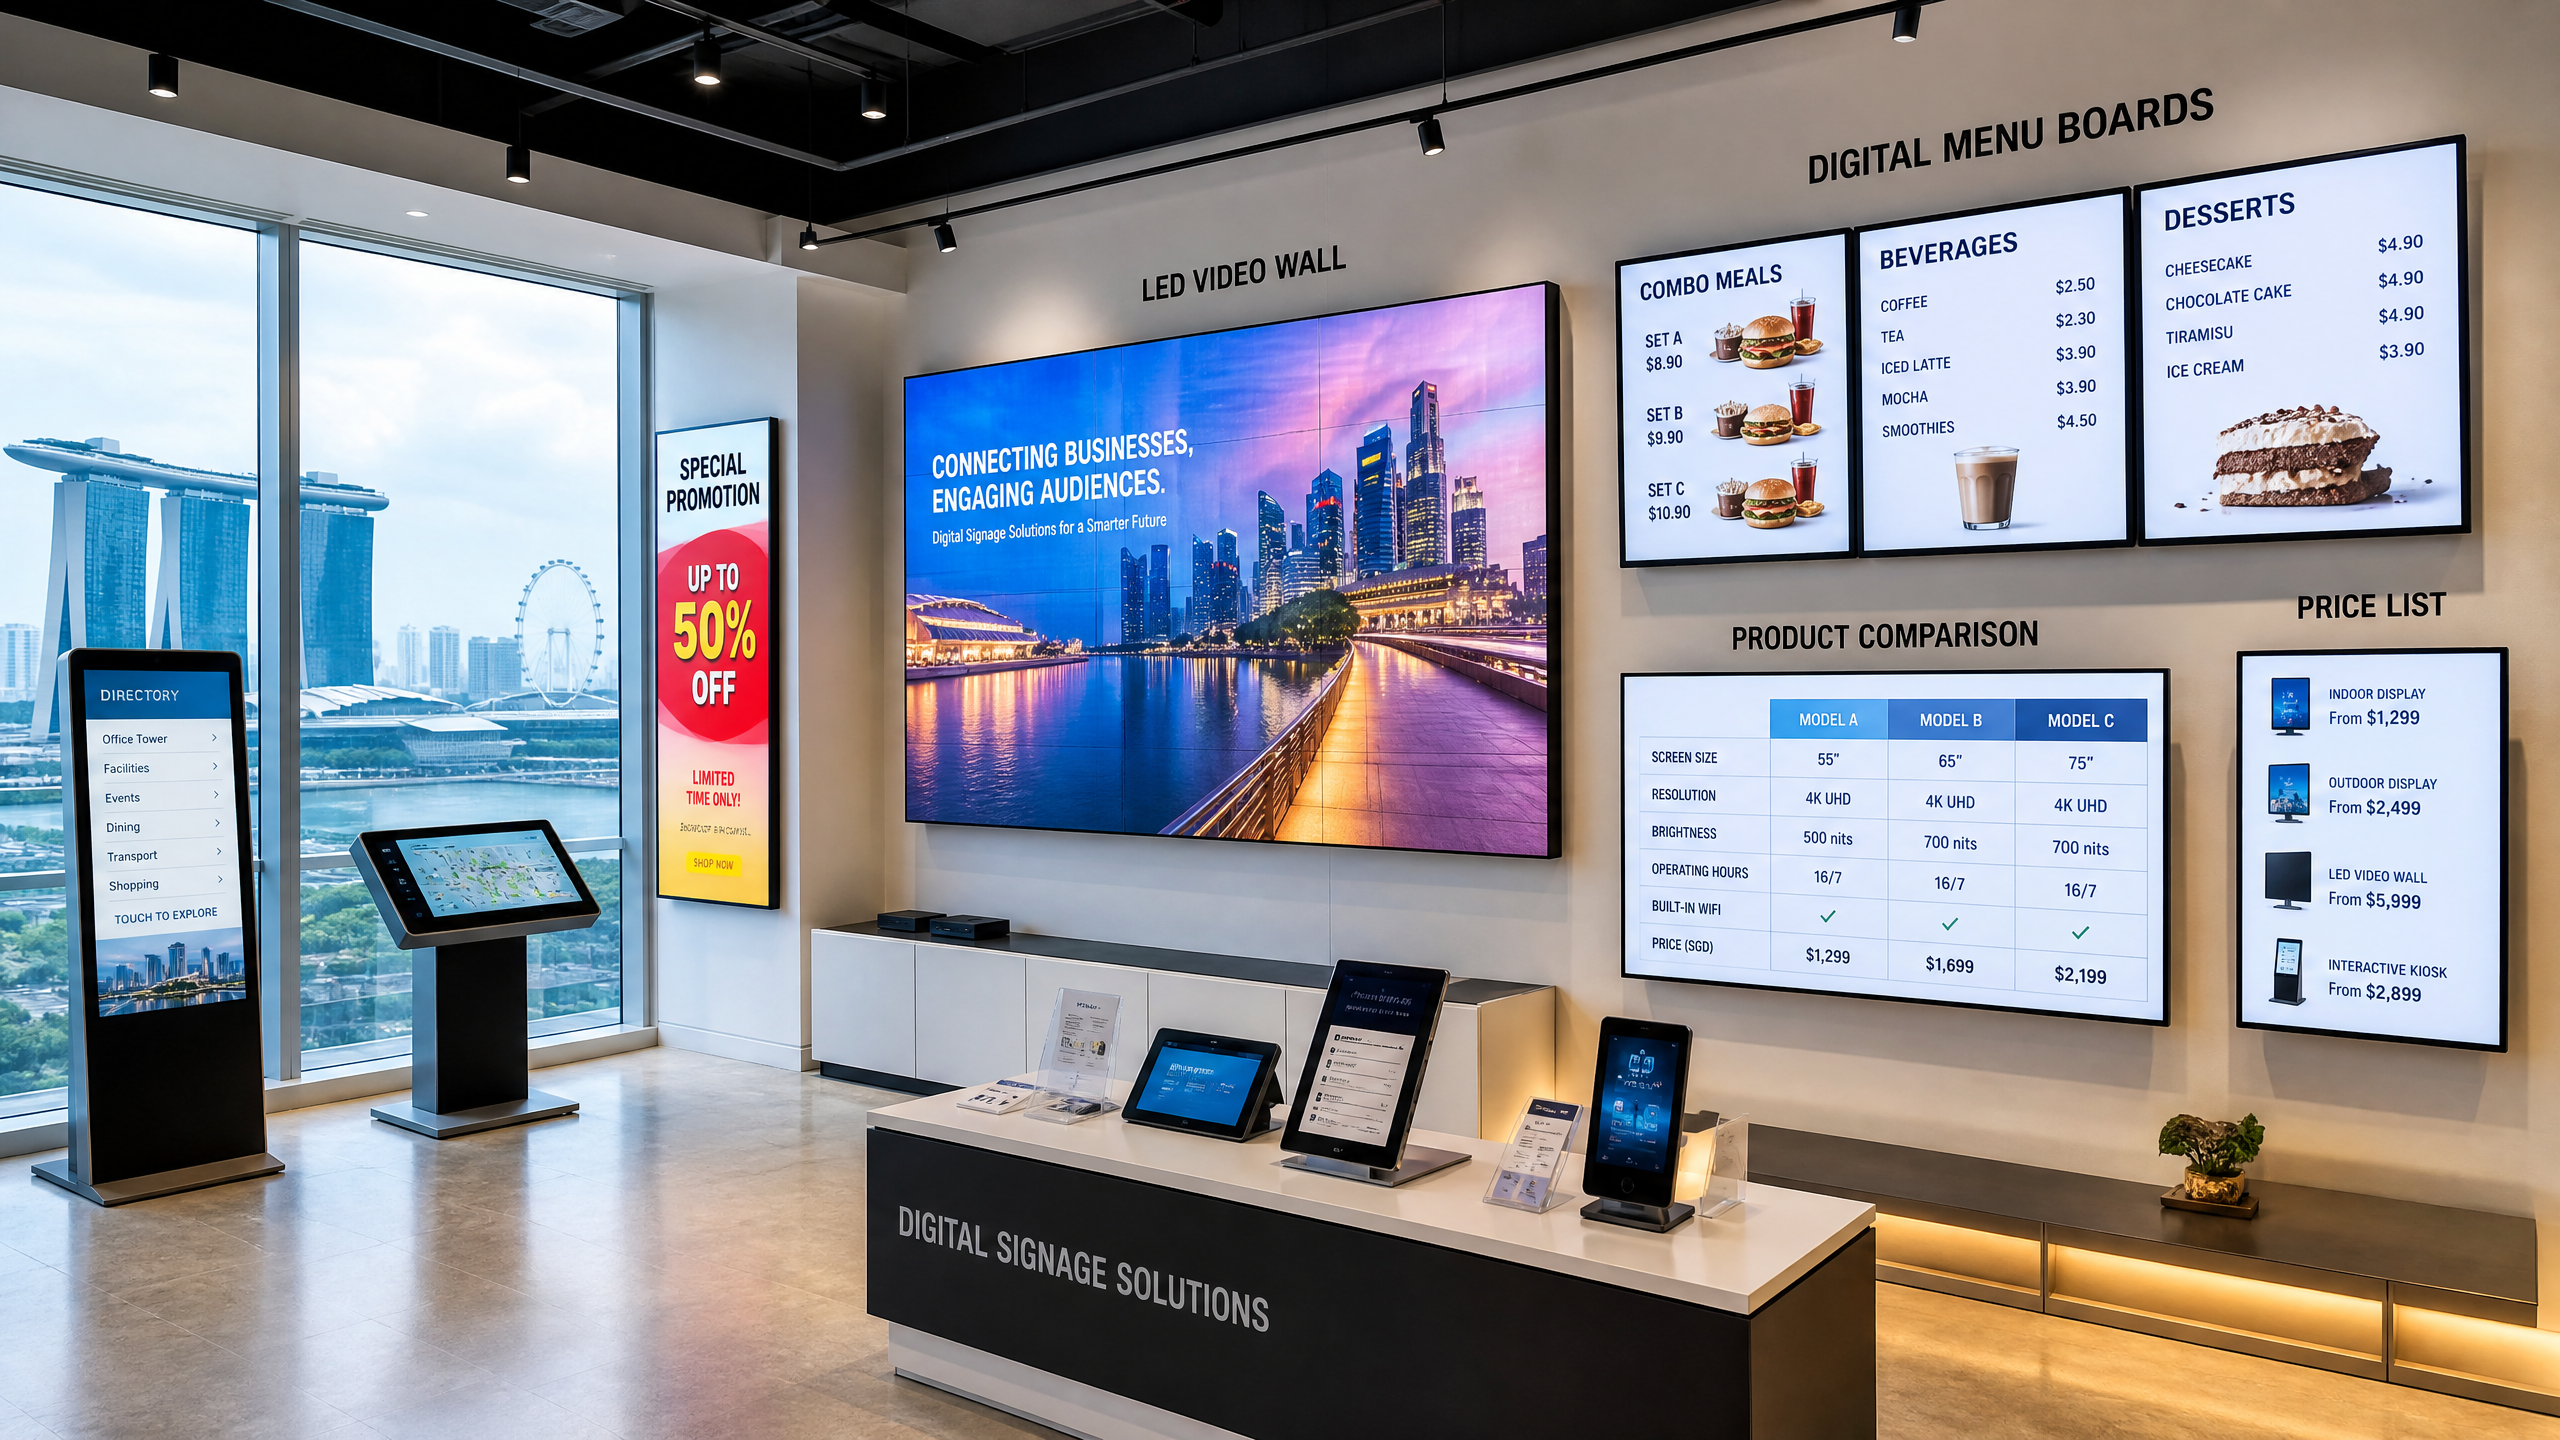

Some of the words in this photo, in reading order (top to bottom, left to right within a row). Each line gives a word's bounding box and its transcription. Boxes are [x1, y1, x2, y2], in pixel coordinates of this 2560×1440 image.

[1809, 138, 1931, 184] DIGITAL
[1944, 117, 2043, 162] MENU
[2059, 88, 2213, 144] BOARDS
[2166, 192, 2294, 231] DESSERTS
[1881, 232, 2017, 269] BEVERAGES
[2166, 255, 2252, 277] CHEESECAKE
[2379, 235, 2423, 253] $4.90
[1143, 273, 1185, 301] LED
[1193, 258, 1265, 293] VIDEO
[1275, 245, 1346, 279] WALL
[1641, 274, 1709, 300] COMBO
[1717, 264, 1782, 290] MEALS
[1881, 296, 1927, 312] COFFEE
[2056, 277, 2094, 295] $2.50
[2166, 289, 2249, 310] CHOCOLATE
[2254, 284, 2291, 300] CAKE
[2379, 270, 2423, 289] $4.90
[1881, 330, 1904, 343] TEA
[2056, 311, 2095, 328] $2.30
[2166, 326, 2232, 344] TIRAMISU
[2380, 306, 2423, 325] $4.90
[1646, 332, 1669, 348] SET
[1673, 331, 1682, 345] A
[1647, 355, 1682, 372] $8.90
[1882, 361, 1909, 374] ICED
[1914, 357, 1950, 371] LATTE
[2057, 345, 2095, 362] $3.90
[2168, 364, 2188, 378] ICE
[2194, 359, 2243, 376] CREAM
[2380, 342, 2424, 360] $3.90
[1883, 391, 1928, 406] MOCHA
[2057, 379, 2096, 396] $3.90
[1647, 407, 1670, 422] SET
[1675, 406, 1682, 420] B
[1883, 421, 1954, 437] SMOOTHIES
[2058, 414, 2096, 430] $4.50
[1648, 430, 1683, 447] $9.90
[933, 443, 1057, 479] CONNECTING
[1065, 429, 1193, 465] BUSINESSES,
[680, 452, 746, 480] SPECIAL
[667, 482, 759, 512] PROMOTION
[933, 481, 1033, 513] ENGAGING
[1040, 468, 1165, 504] AUDIENCES.
[1649, 483, 1672, 497] SET
[1676, 482, 1684, 495] C
[1649, 505, 1690, 522] $10.90
[933, 529, 963, 547] Digital
[966, 528, 1006, 544] Signage
[1009, 523, 1056, 538] Solutions
[1059, 520, 1074, 534] for
[1078, 522, 1083, 533] a
[1087, 518, 1129, 532] Smarter
[1132, 514, 1167, 528] Future
[688, 565, 712, 594] UP
[716, 563, 740, 592] TO
[2298, 594, 2376, 619] PRICE
[2388, 592, 2446, 617] LIST
[674, 600, 756, 662] 50%
[1733, 625, 1849, 650] PRODUCT
[1859, 621, 2037, 649] COMPARISON
[101, 690, 179, 701] DIRECTORY
[692, 670, 736, 707] OFF
[2330, 689, 2373, 699] INDOOR
[2378, 689, 2425, 699] DISPLAY
[1800, 713, 1845, 726] MODEL
[1849, 713, 1858, 725] A
[1921, 714, 1968, 726] MODEL
[1974, 714, 1982, 726] B
[2049, 714, 2099, 727] MODEL
[2105, 714, 2114, 727] C
[2330, 711, 2361, 724] From
[2367, 709, 2419, 727] $1,299
[103, 735, 133, 744] Office
[137, 734, 167, 743] Tower
[104, 764, 149, 773] Facilities
[1652, 751, 1691, 763] SCREEN
[1696, 752, 1717, 763] SIZE
[693, 770, 734, 786] LIMITED
[2329, 777, 2384, 788] OUTDOOR
[2389, 778, 2437, 789] DISPLAY
[106, 794, 140, 803] Events
[686, 791, 710, 805] TIME
[713, 792, 740, 807] ONLY!
[1653, 789, 1715, 801] RESOLUTION
[1806, 792, 1821, 804] 4K
[1826, 792, 1850, 805] UHD
[1926, 795, 1942, 808] 4K
[1948, 796, 1974, 808] UHD
[2055, 799, 2072, 811] 4K
[2078, 799, 2107, 812] UHD
[2330, 800, 2361, 813] From
[2367, 799, 2420, 817] $2,499
[107, 823, 140, 833] Dining
[1652, 826, 1716, 839] BRIGHTNESS
[1804, 831, 1826, 844] 500
[1831, 833, 1852, 845] nits
[1925, 835, 1948, 848] 700
[1954, 837, 1977, 850] nits
[2053, 840, 2079, 854] 700
[2084, 842, 2109, 855] nits
[107, 851, 157, 862] Transport
[694, 858, 713, 868] SHOP
[716, 860, 733, 870] NOW
[110, 881, 158, 892] Shopping
[1652, 863, 1708, 876] OPERATING
[1713, 866, 1748, 878] HOURS
[1815, 871, 1841, 884] 16/7
[1935, 877, 1964, 891] 16/7
[2065, 883, 2096, 898] 16/7
[2329, 869, 2350, 880] LED
[2355, 870, 2389, 882] VIDEO
[2394, 872, 2427, 883] WALL
[1653, 900, 1694, 913] BUILT-IN
[1698, 903, 1720, 915] WIFI
[2330, 892, 2361, 906] From
[2367, 891, 2420, 910] $5,999
[115, 913, 152, 924] TOUCH
[156, 911, 169, 920] TO
[173, 907, 217, 919] EXPLORE
[1653, 937, 1681, 950] PRICE
[1685, 940, 1713, 954] (SGD)
[1807, 947, 1850, 964] $1,299
[1926, 956, 1973, 973] $1,699
[2055, 965, 2106, 984] $2,199
[2329, 959, 2406, 975] INTERACTIVE
[2411, 965, 2447, 978] KIOSK
[2330, 982, 2361, 997] From
[2367, 983, 2421, 1002] $2,899
[900, 1206, 987, 1257] DIGITAL
[997, 1231, 1106, 1289] SIGNAGE
[1117, 1262, 1269, 1332] SOLUTIONS
